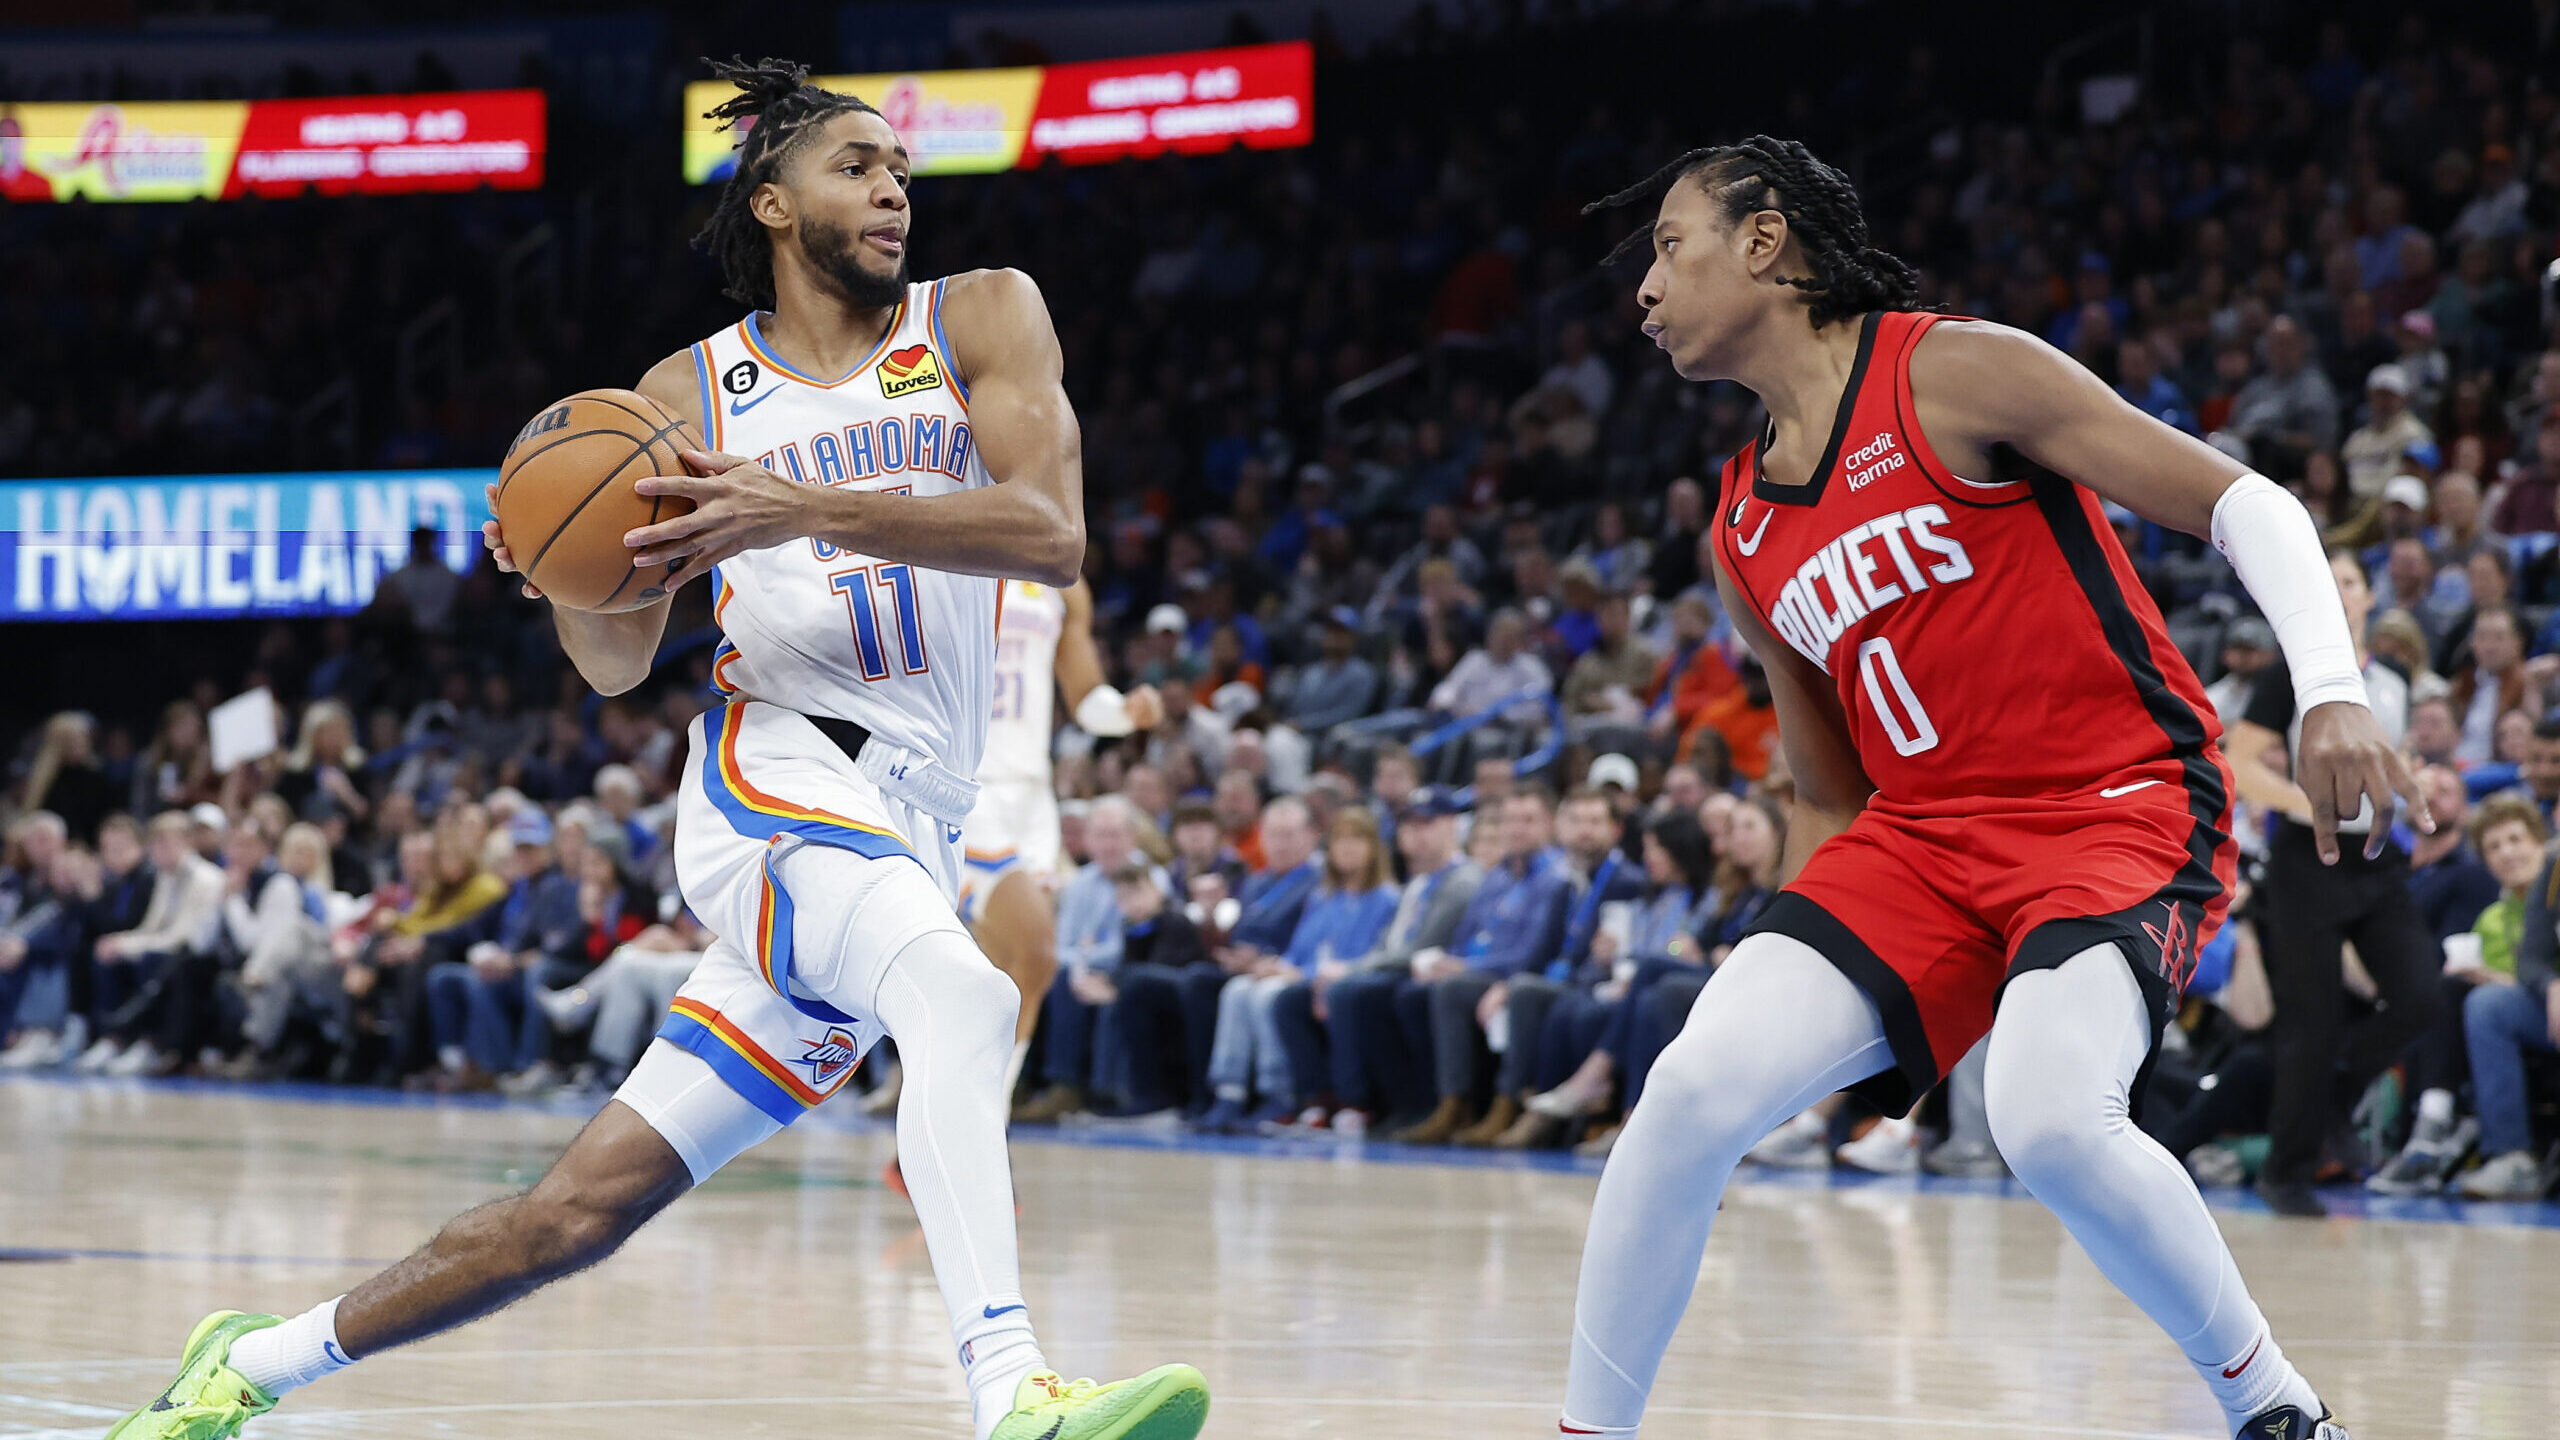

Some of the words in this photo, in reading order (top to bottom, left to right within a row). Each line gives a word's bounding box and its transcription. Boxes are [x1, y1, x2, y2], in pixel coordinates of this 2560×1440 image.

[732, 364, 751, 391] 6
[1845, 432, 1896, 470] credit
[1846, 452, 1905, 492] karma
[828, 561, 930, 682] 11
[1771, 503, 1974, 676] ROCKETS
[1858, 636, 1939, 757] 0
